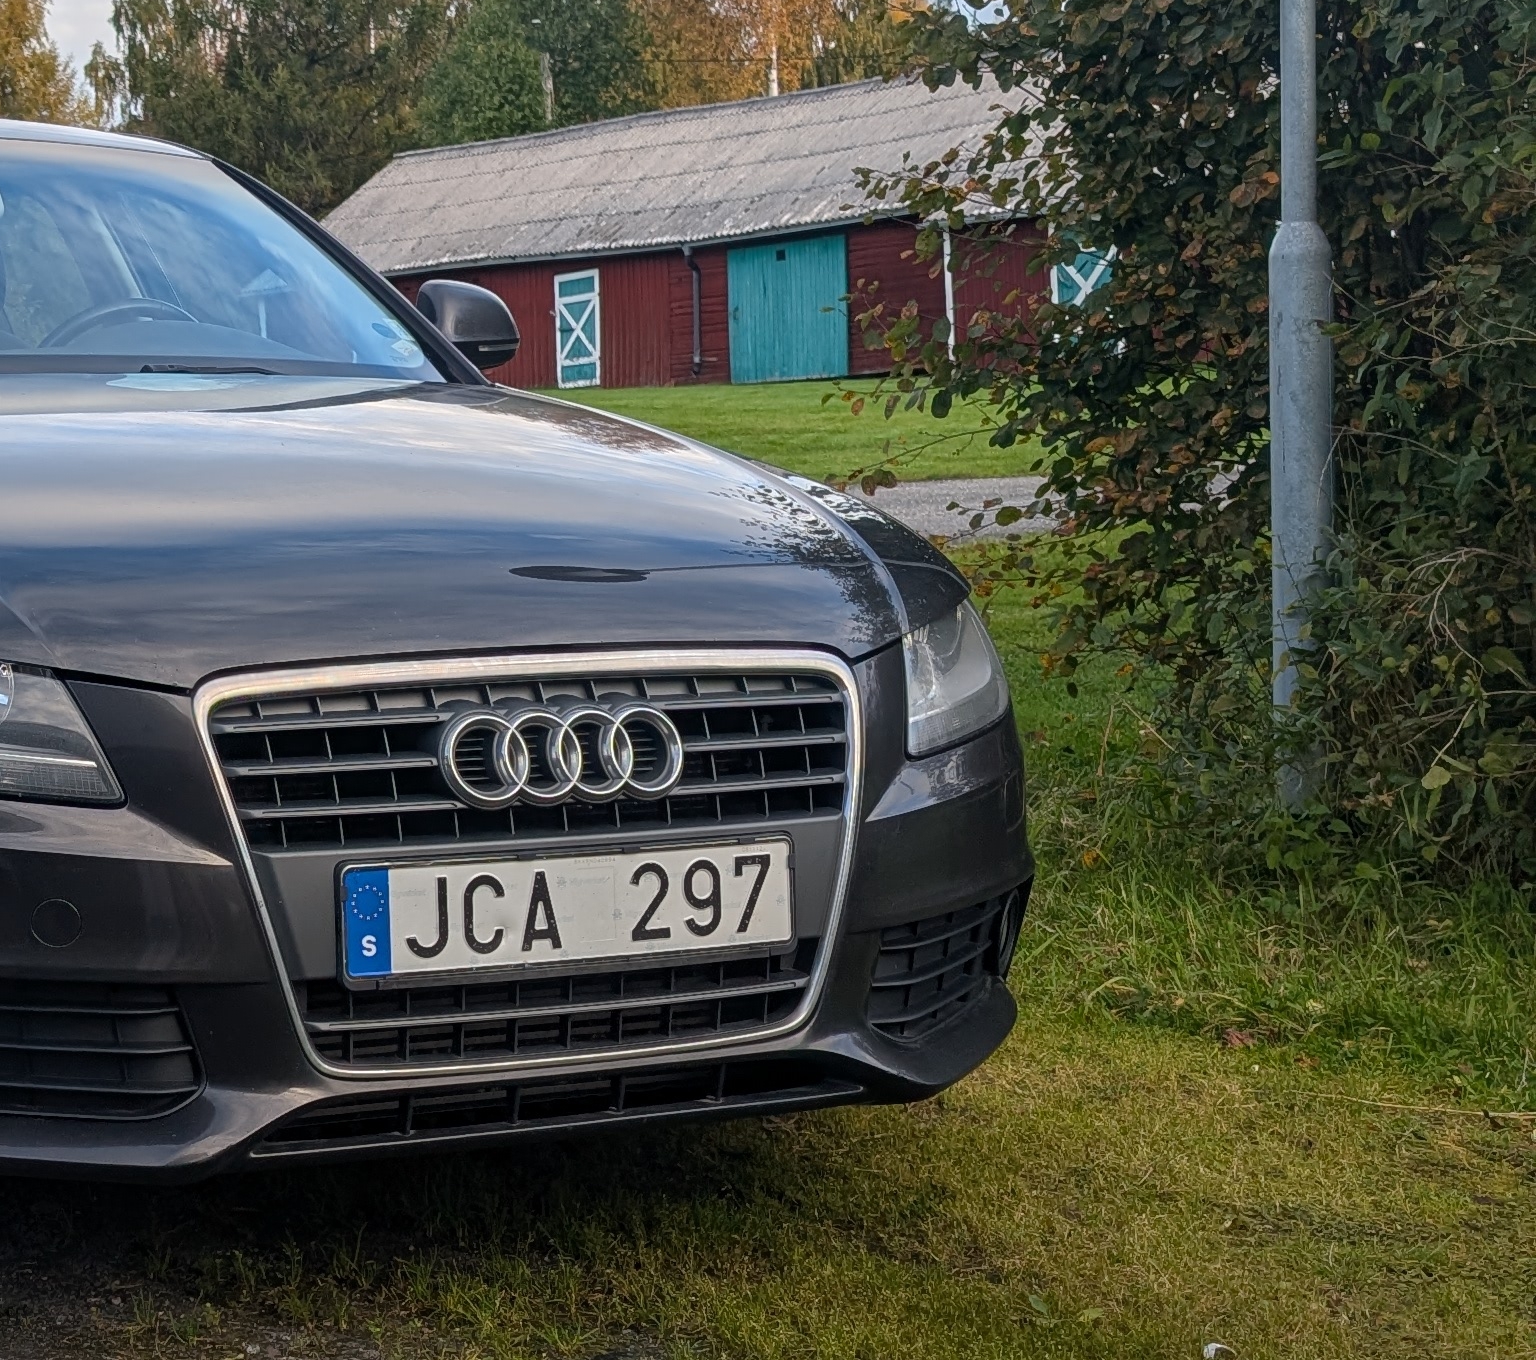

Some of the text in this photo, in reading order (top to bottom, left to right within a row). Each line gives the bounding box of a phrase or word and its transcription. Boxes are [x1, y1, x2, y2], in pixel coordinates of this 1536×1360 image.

[406, 853, 771, 958] JCA 297
[361, 935, 377, 957] S
